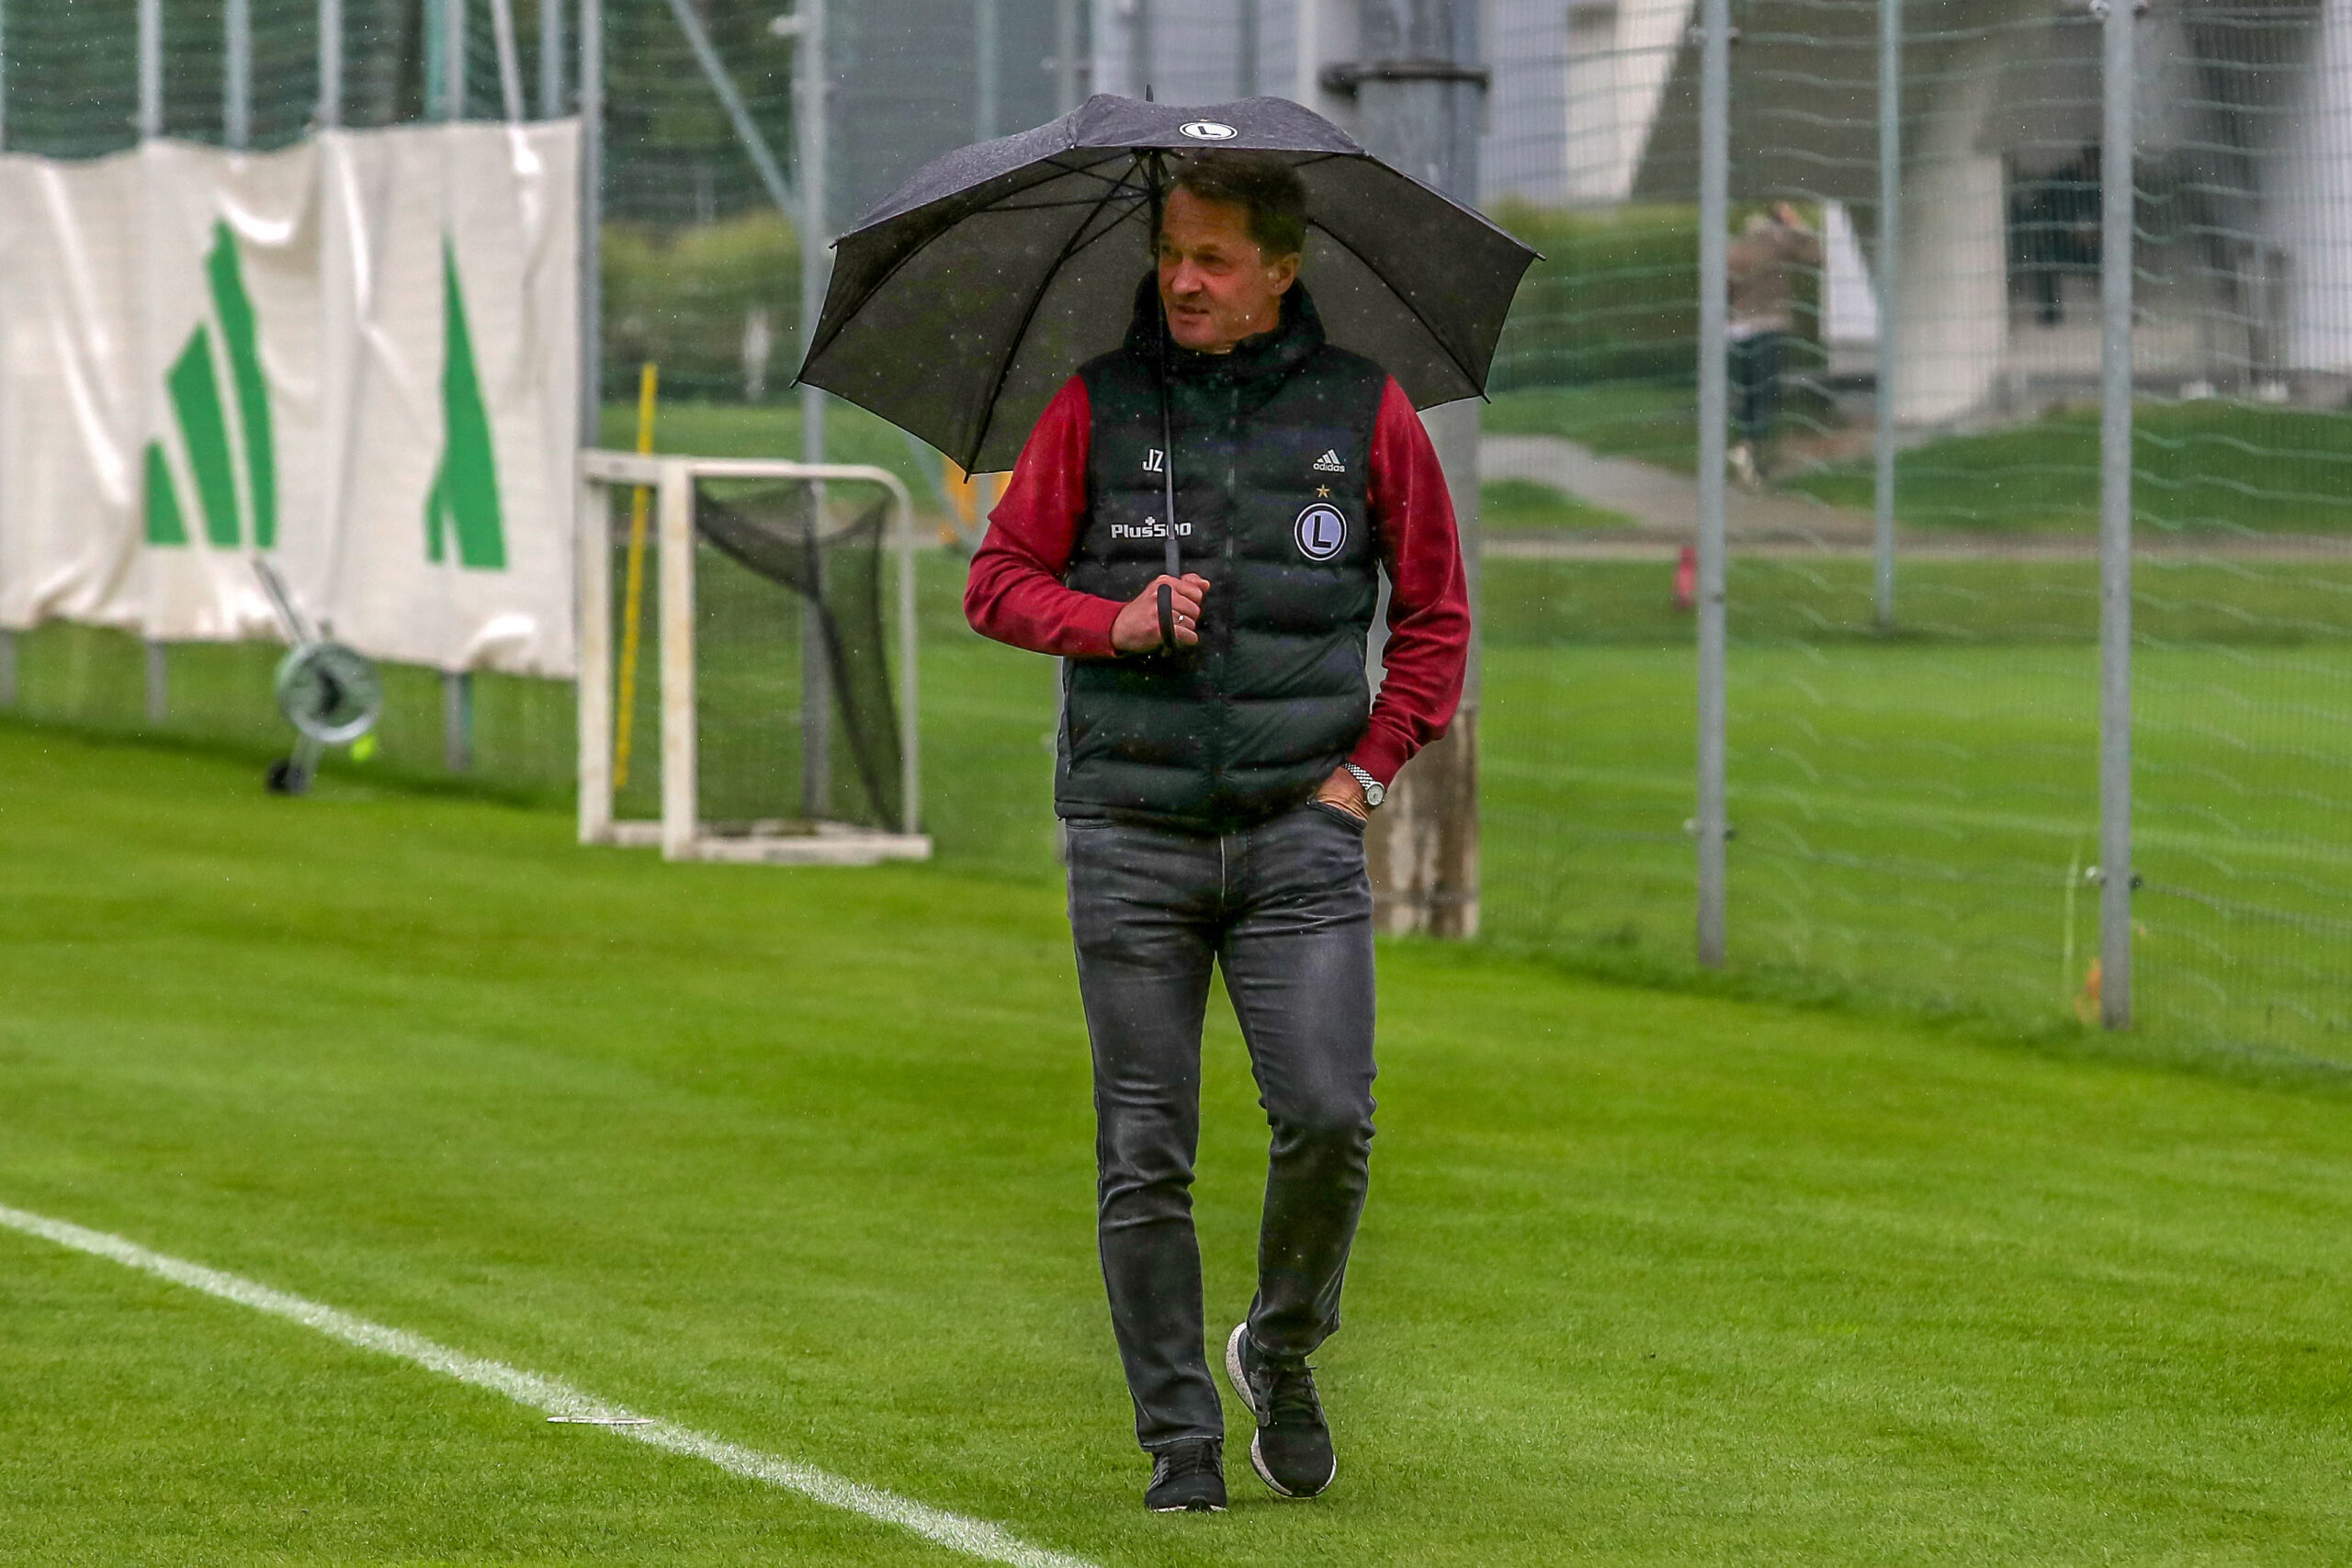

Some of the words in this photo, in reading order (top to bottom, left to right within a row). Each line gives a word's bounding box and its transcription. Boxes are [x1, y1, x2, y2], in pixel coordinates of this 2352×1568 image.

[1142, 448, 1164, 472] JZ
[1312, 463, 1346, 473] adidas
[1311, 513, 1333, 549] L
